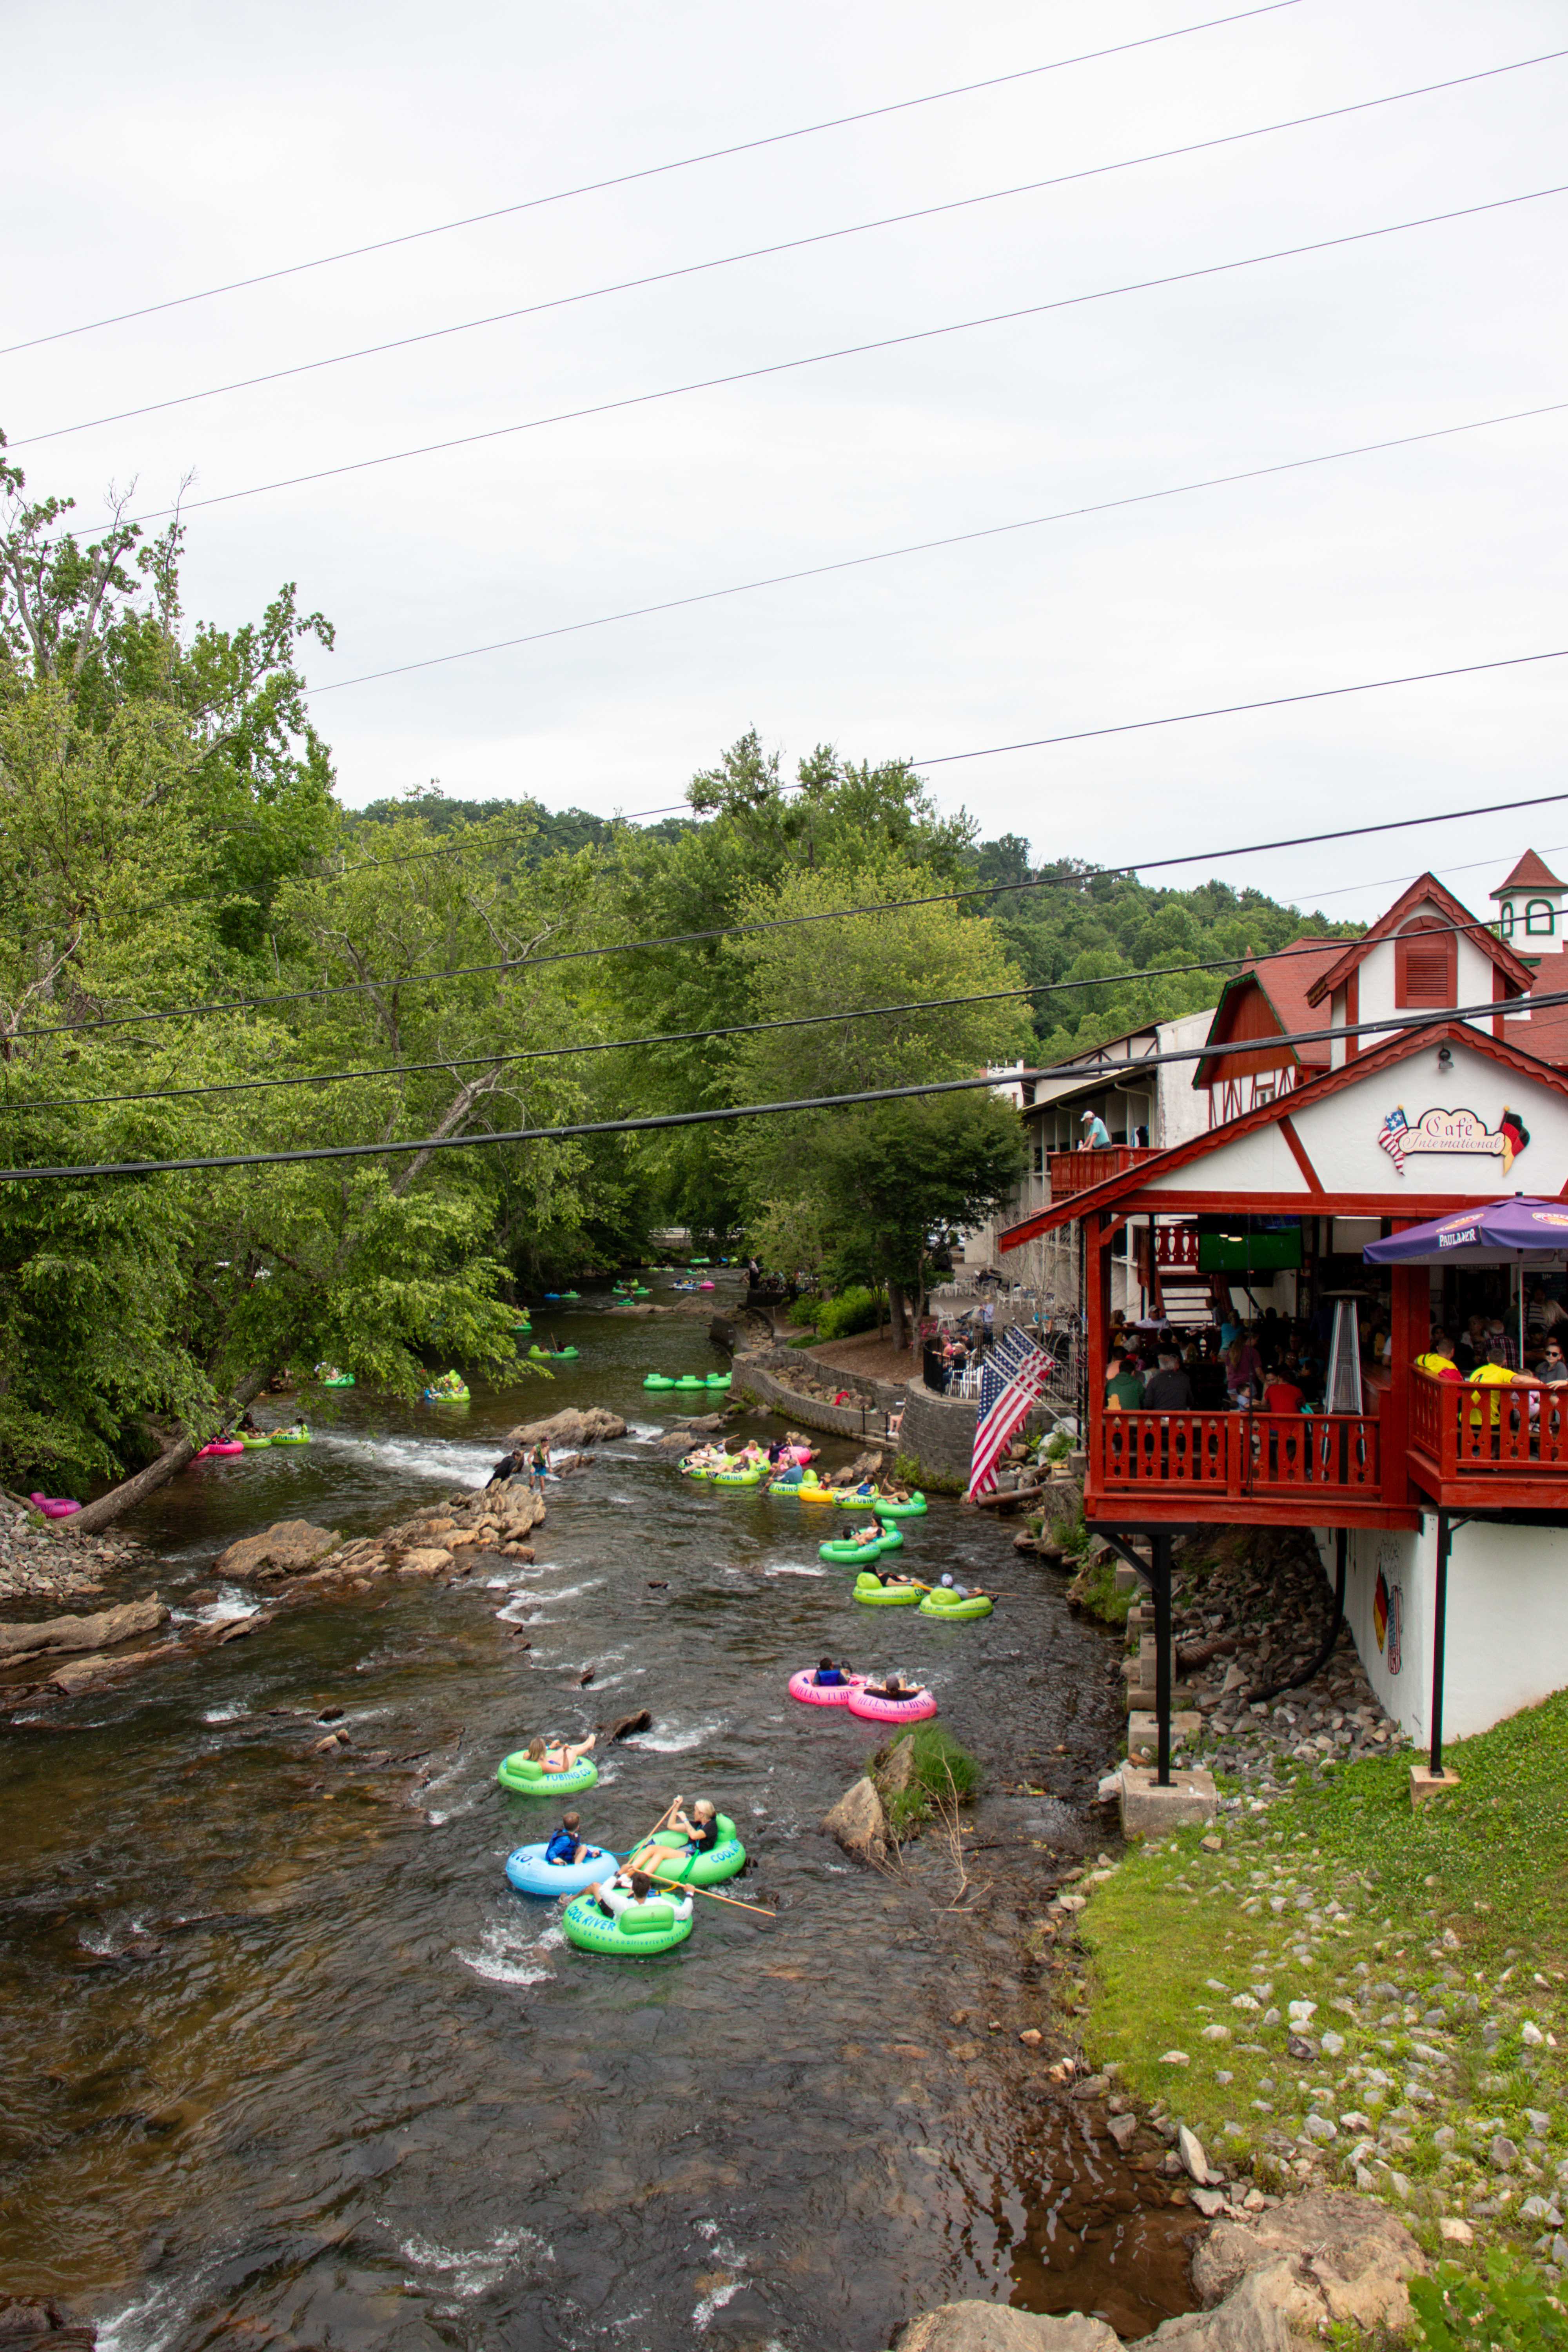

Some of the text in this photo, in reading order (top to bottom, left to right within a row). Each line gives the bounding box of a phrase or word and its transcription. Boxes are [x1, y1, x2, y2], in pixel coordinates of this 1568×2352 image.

[1402, 1132, 1501, 1150] International
[1439, 1228, 1477, 1247] PAULANER
[795, 1686, 820, 1700] HELEN
[857, 1697, 930, 1709] HELEN TUBING
[546, 1771, 580, 1782] TUBING
[710, 1849, 735, 1863] COOL
[567, 1906, 616, 1932] COOL RIVER
